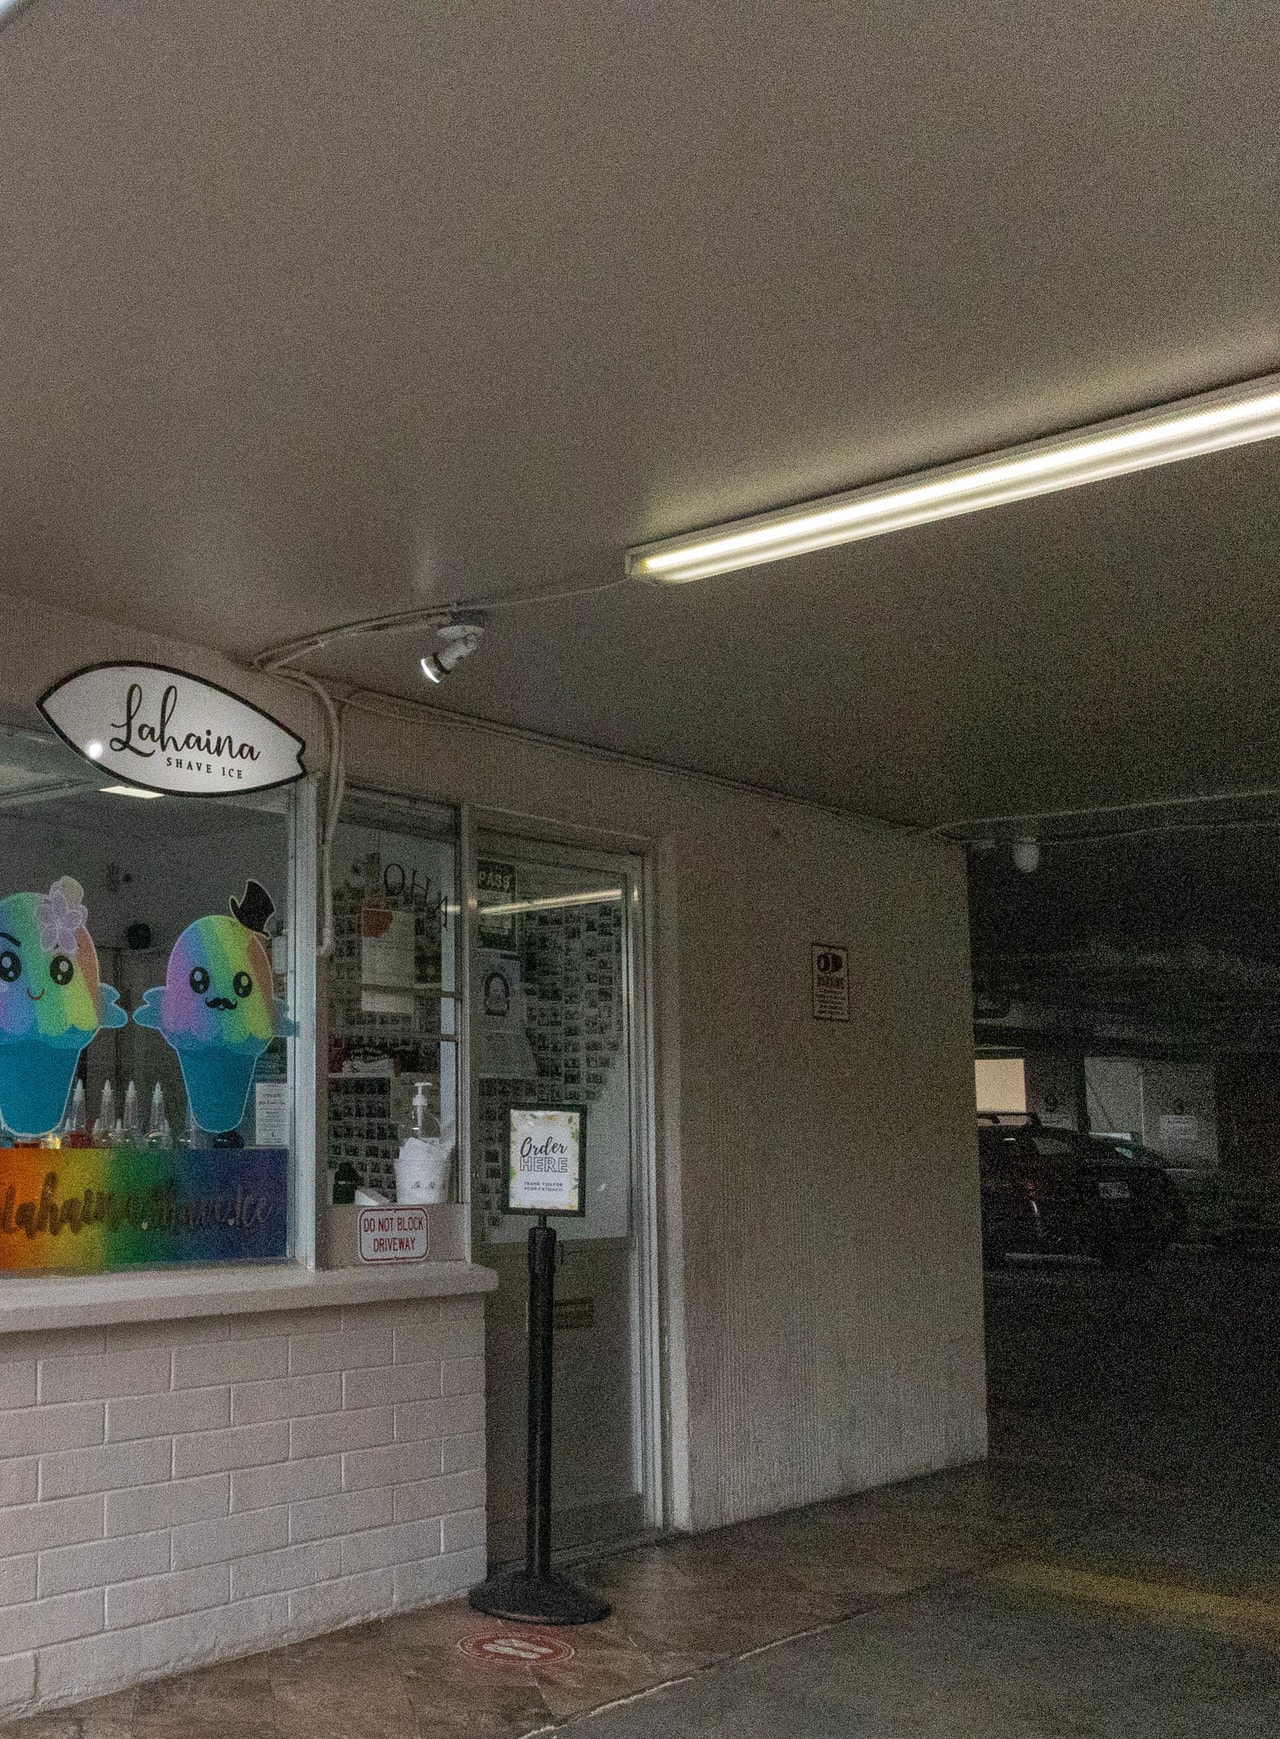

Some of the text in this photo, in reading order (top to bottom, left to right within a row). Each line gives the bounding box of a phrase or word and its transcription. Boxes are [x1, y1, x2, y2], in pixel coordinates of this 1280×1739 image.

[109, 683, 261, 762] Lahaina
[166, 757, 243, 780] SHAVE ICE
[520, 1136, 568, 1158] Order
[520, 1155, 568, 1173] HERE
[363, 1216, 424, 1232] DO NOT BLOCK
[373, 1236, 417, 1252] DRIVEWAY
